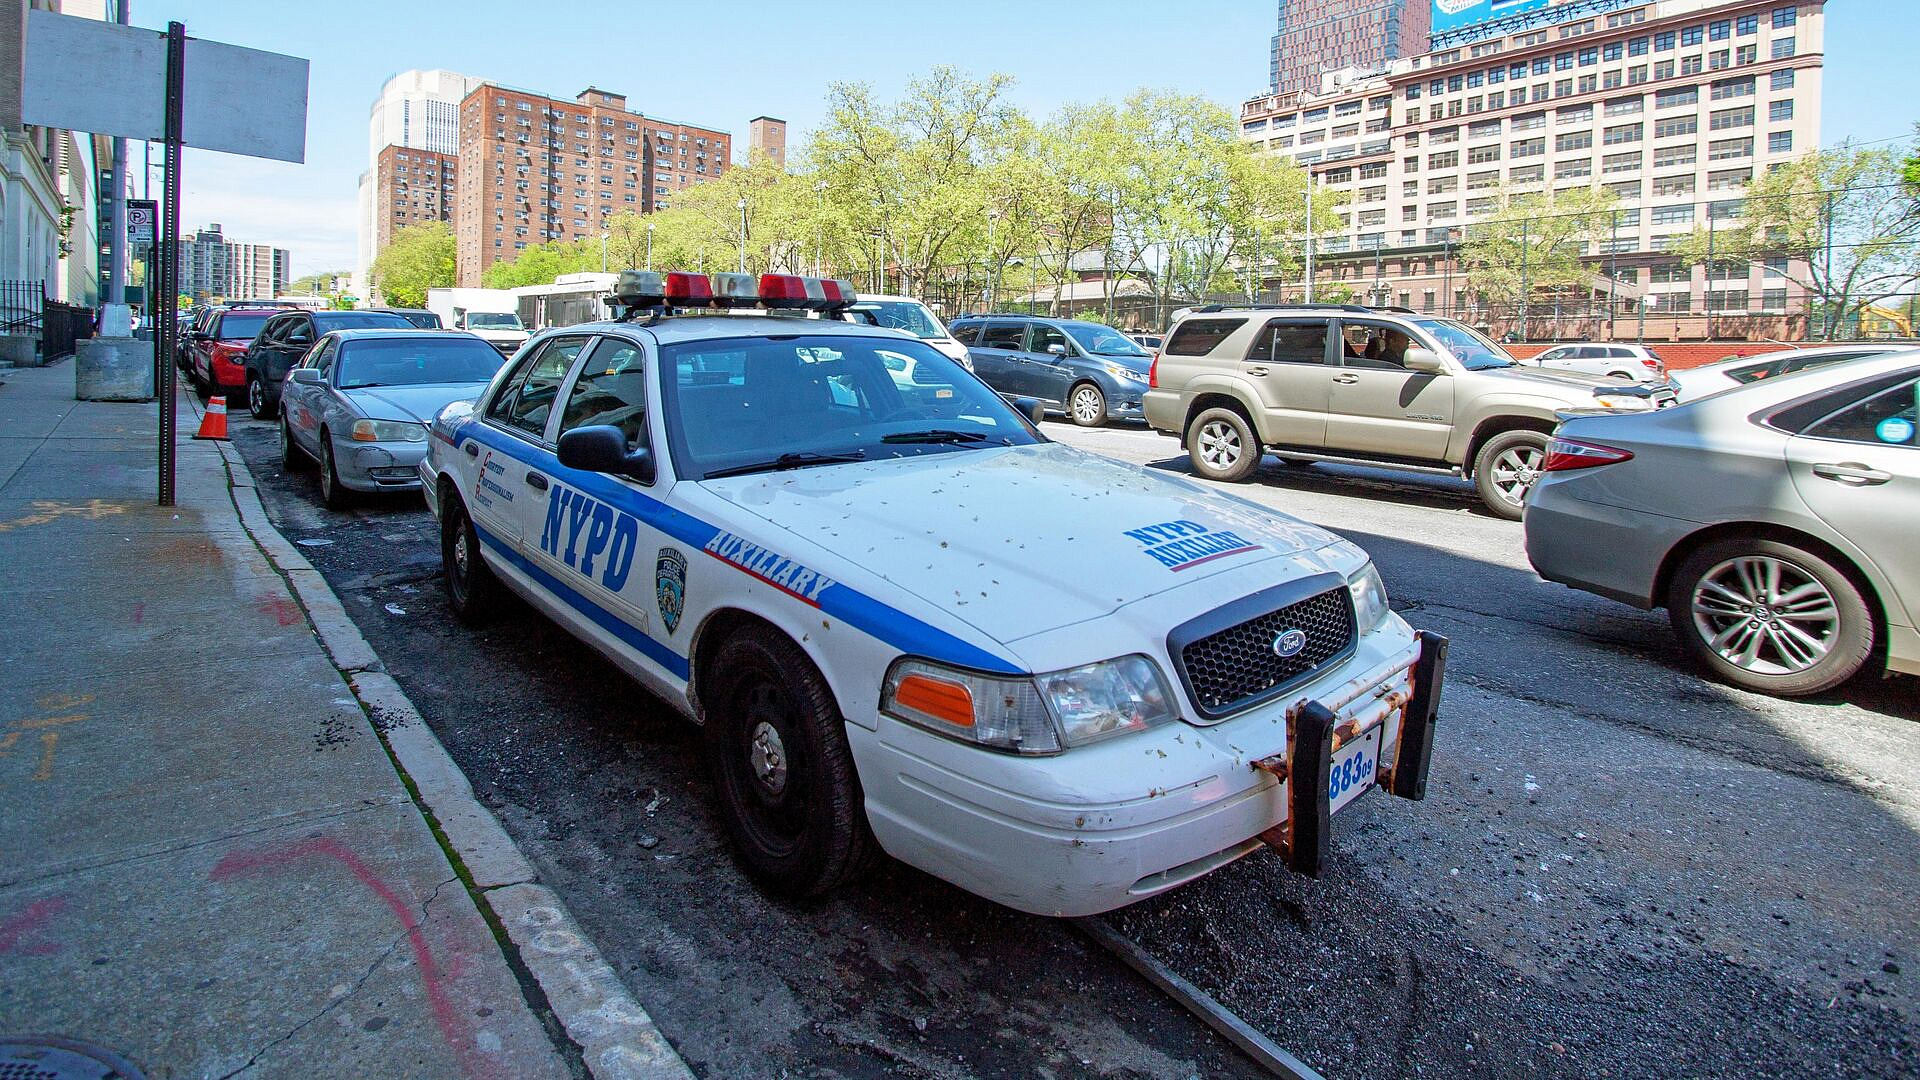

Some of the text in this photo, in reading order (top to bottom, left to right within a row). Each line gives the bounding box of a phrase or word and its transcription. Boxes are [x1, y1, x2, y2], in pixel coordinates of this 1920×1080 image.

[541, 484, 638, 593] NYPD
[1122, 520, 1209, 546] NYPD
[1144, 531, 1254, 567] AUXILIARY
[663, 560, 681, 575] POLICE
[704, 530, 837, 602] AUXILIARY
[1283, 635, 1300, 651] Ford
